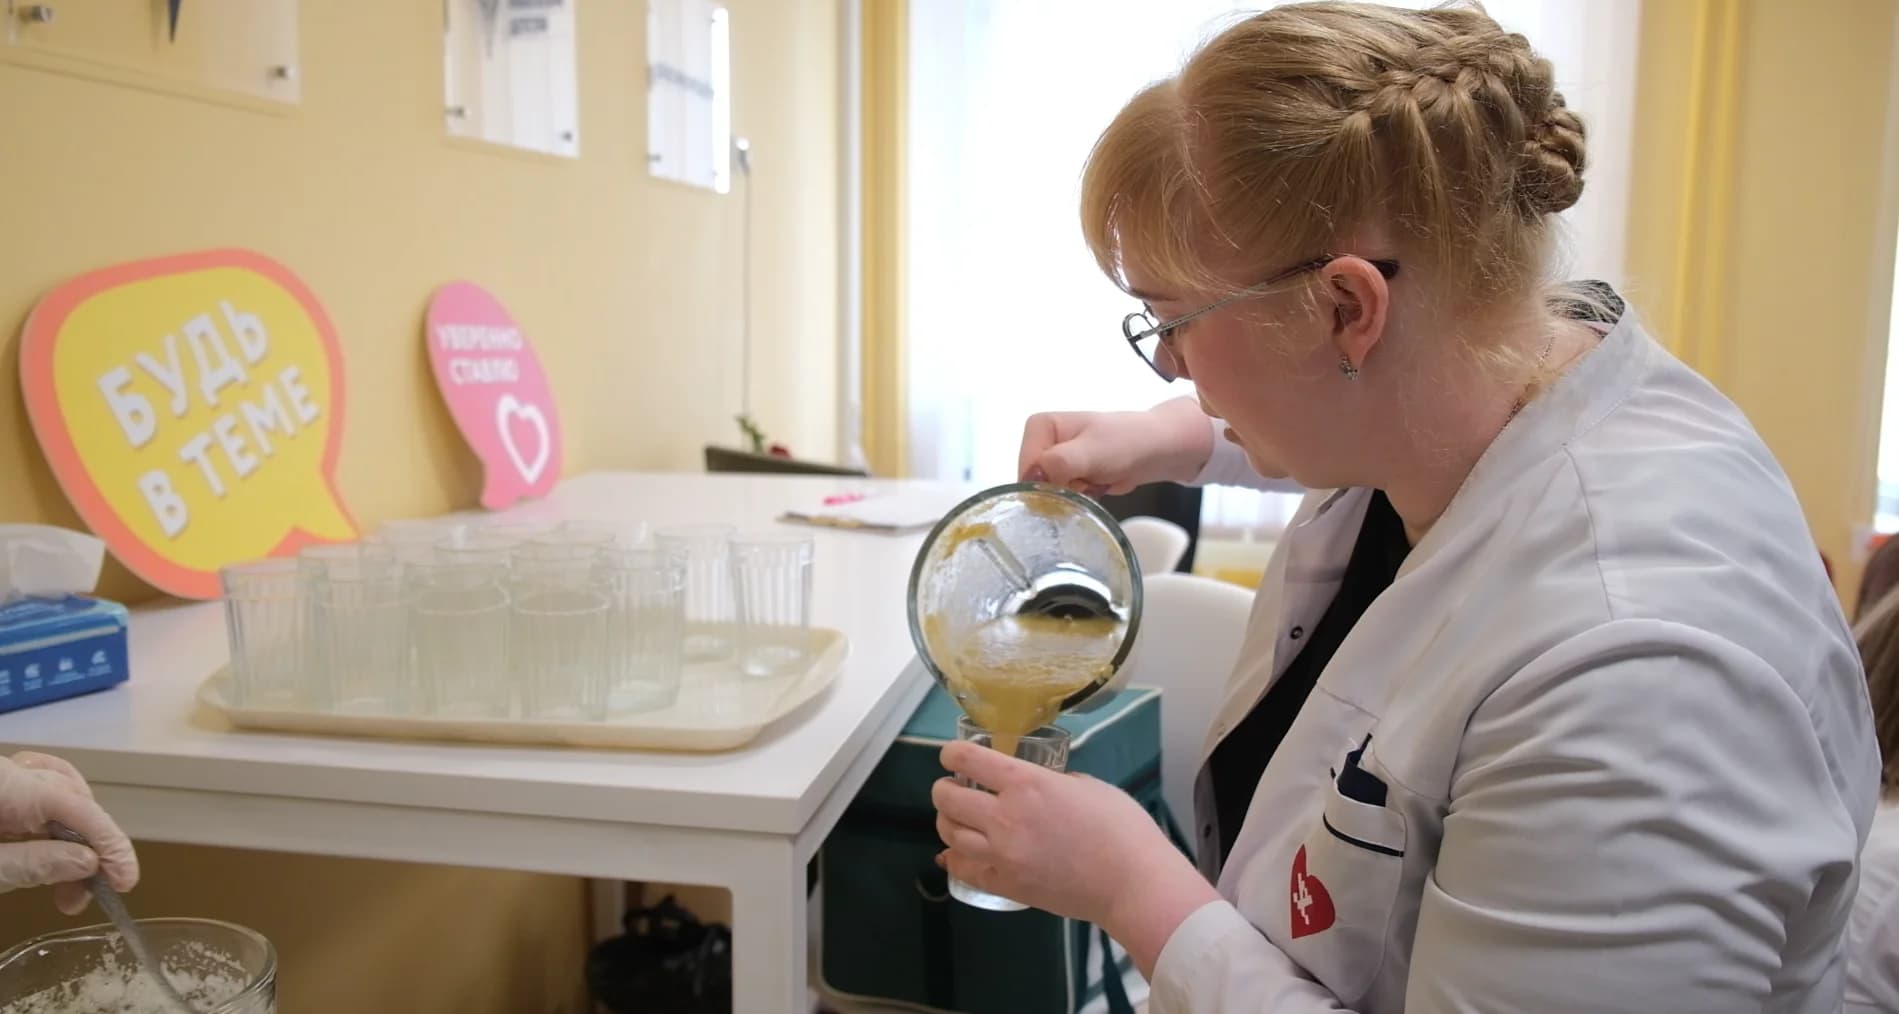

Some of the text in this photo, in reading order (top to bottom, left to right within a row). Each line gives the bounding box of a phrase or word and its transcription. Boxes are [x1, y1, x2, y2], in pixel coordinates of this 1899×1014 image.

[97, 299, 268, 449] БУДЬ
[138, 363, 321, 540] В ТЕМЕ
